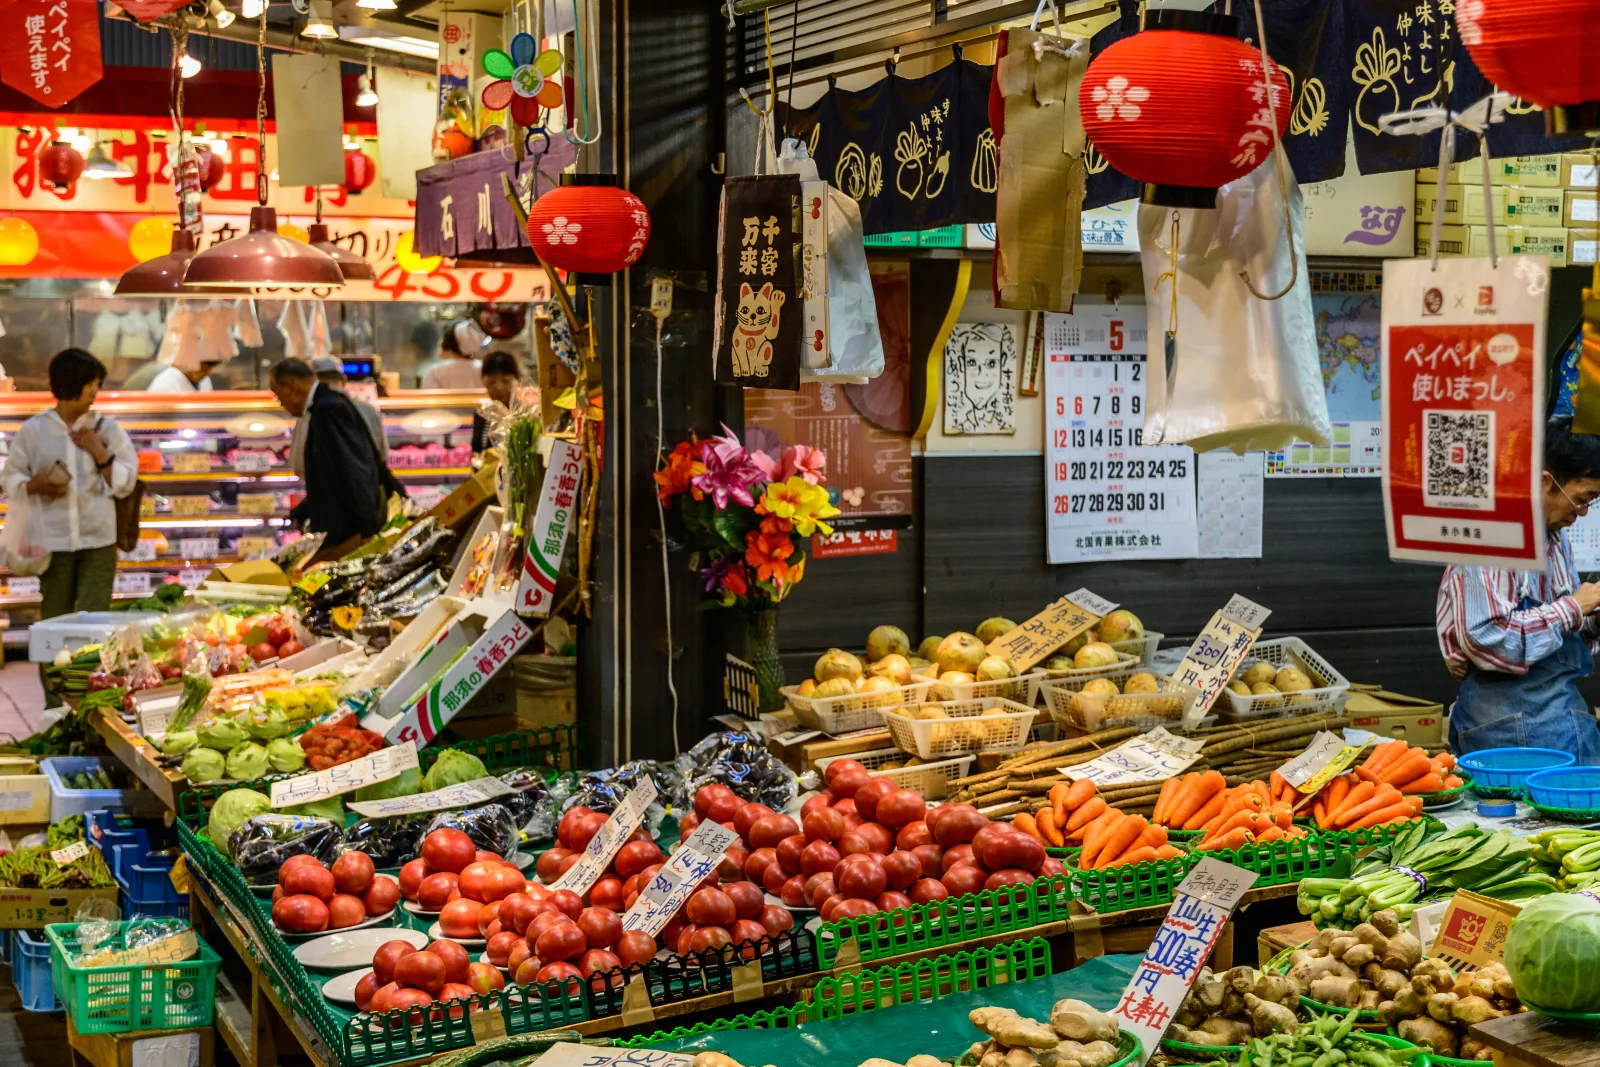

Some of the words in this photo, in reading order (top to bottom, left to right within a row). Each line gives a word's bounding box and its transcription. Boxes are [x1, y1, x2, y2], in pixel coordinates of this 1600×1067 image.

[48, 1, 71, 71] ペイペイ
[1397, 12, 1414, 84] 仲よし
[1415, 0, 1436, 74] 味よし
[25, 15, 51, 94] 使えます。
[921, 113, 933, 165] 仲よし
[1343, 205, 1406, 246] なす
[739, 216, 760, 276] 万来
[761, 215, 780, 277] 千客
[1110, 320, 1124, 351] 5
[1404, 343, 1482, 370] ペイペイ
[1113, 363, 1118, 382] 1
[1132, 363, 1141, 382] 2
[1412, 373, 1515, 402] 使いまっし。
[1056, 396, 1065, 416] 5
[1074, 396, 1083, 415] 6
[1093, 396, 1101, 415] 7
[1111, 396, 1120, 415] 8
[1131, 396, 1141, 414] 9
[1053, 429, 1068, 449] 12
[1071, 429, 1086, 448] 13
[1089, 428, 1103, 448] 14
[1108, 428, 1123, 447] 15
[1053, 461, 1068, 482] 19
[1071, 461, 1086, 480] 20
[1089, 461, 1104, 480] 21
[1107, 460, 1124, 479] 22
[1127, 460, 1145, 479] 23
[1148, 459, 1165, 479] 24
[1169, 459, 1187, 478] 25
[1053, 494, 1069, 514] 26
[1071, 494, 1086, 513] 27
[1089, 494, 1104, 512] 28
[1107, 493, 1124, 512] 29
[1127, 492, 1145, 512] 30
[1149, 492, 1165, 511] 31
[1075, 534, 1162, 549] 北国青果株式会社
[1195, 639, 1220, 658] 300
[440, 622, 530, 713] 那須の春香うど
[1106, 752, 1139, 773] 200
[650, 872, 673, 893] 500
[1172, 895, 1202, 921] 1山
[1146, 926, 1187, 968] 500
[1172, 909, 1216, 980] 生姜
[1135, 969, 1162, 995] 円
[1115, 992, 1170, 1030] 大奉仕
